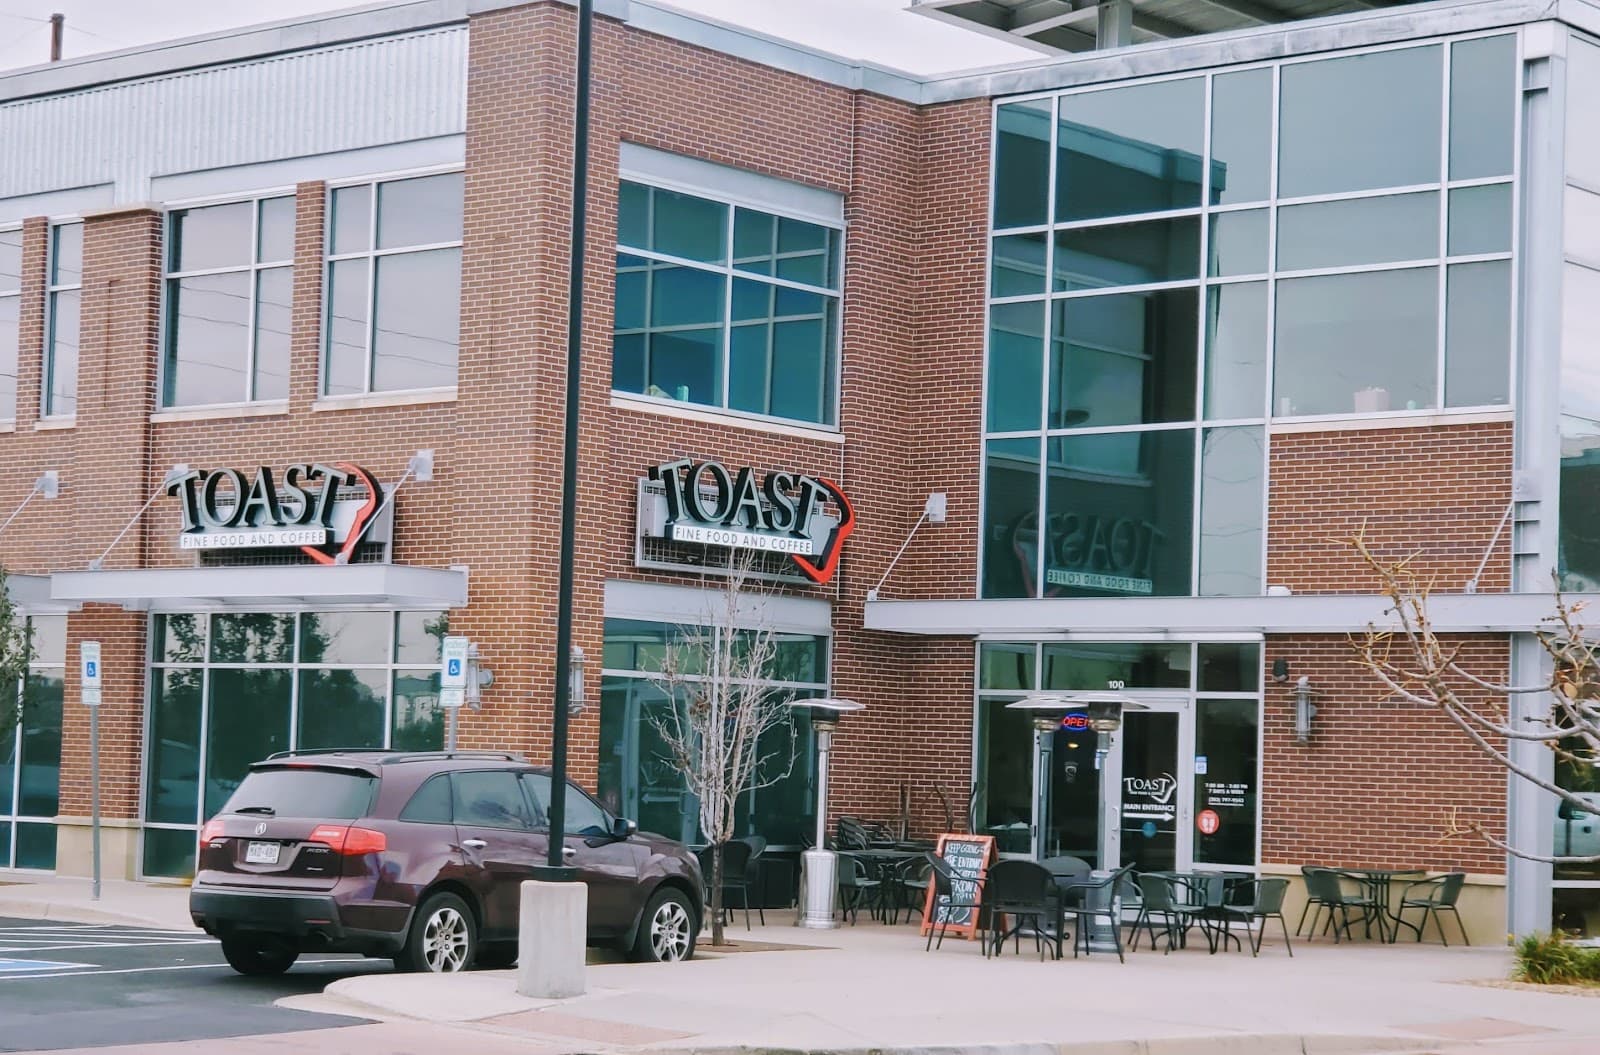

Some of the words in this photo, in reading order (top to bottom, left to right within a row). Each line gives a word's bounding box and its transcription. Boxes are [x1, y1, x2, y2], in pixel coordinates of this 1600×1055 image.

[166, 463, 354, 532] TOAST
[649, 458, 830, 538] TOAST
[183, 535, 208, 547] FINE
[213, 534, 245, 546] FOOD
[251, 533, 275, 545] AND
[280, 531, 325, 544] COFFEE
[675, 526, 700, 540] FINE
[706, 530, 738, 544] FOOD
[743, 535, 767, 548] AND
[771, 538, 812, 553] COFFEE
[1108, 681, 1125, 689] 100
[1124, 777, 1170, 796] TOAST
[1142, 804, 1176, 812] ENTRANCE
